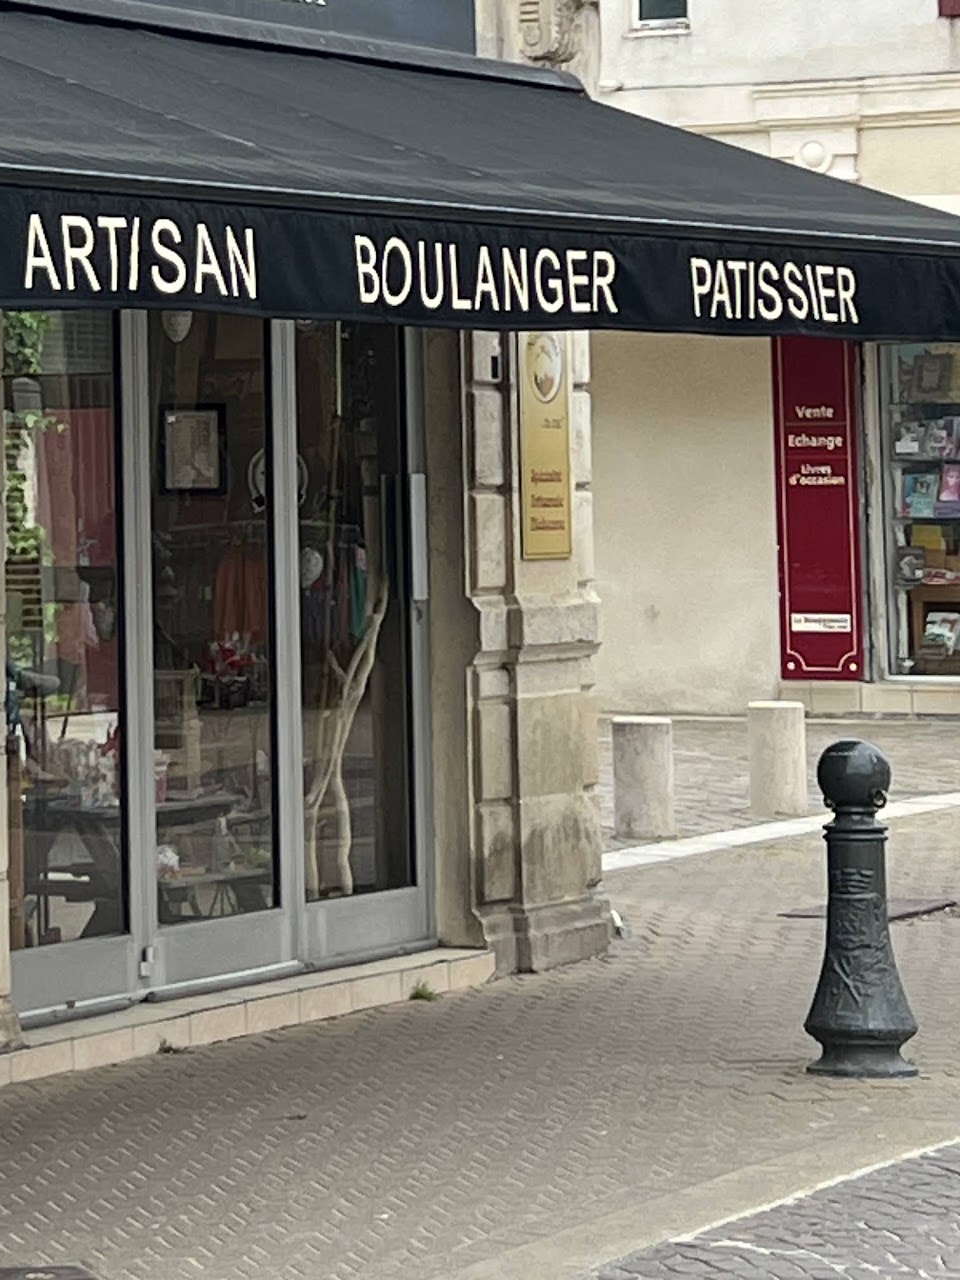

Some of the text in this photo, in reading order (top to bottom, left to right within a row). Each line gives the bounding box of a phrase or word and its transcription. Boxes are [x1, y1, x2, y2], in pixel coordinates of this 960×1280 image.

[24, 213, 860, 325] ARTISAN BOULANGER PATISSIER
[794, 405, 834, 418] Vente
[787, 433, 844, 451] Echange
[800, 463, 833, 475] Livres
[788, 473, 846, 486] d'occasion
